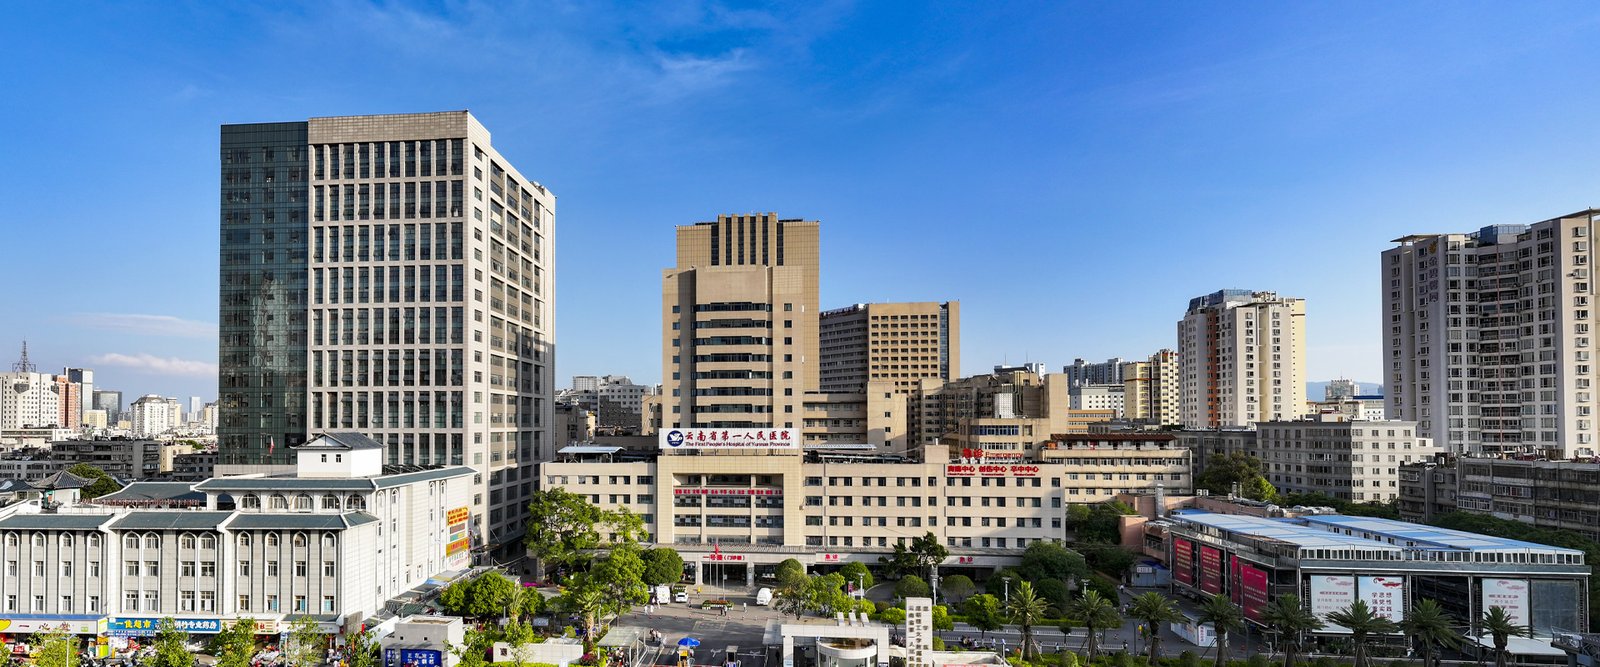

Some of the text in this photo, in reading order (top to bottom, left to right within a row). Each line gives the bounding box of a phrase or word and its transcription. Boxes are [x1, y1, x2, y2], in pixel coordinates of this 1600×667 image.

[685, 430, 791, 441] 云南省第一人民医院
[963, 448, 983, 458] 急诊
